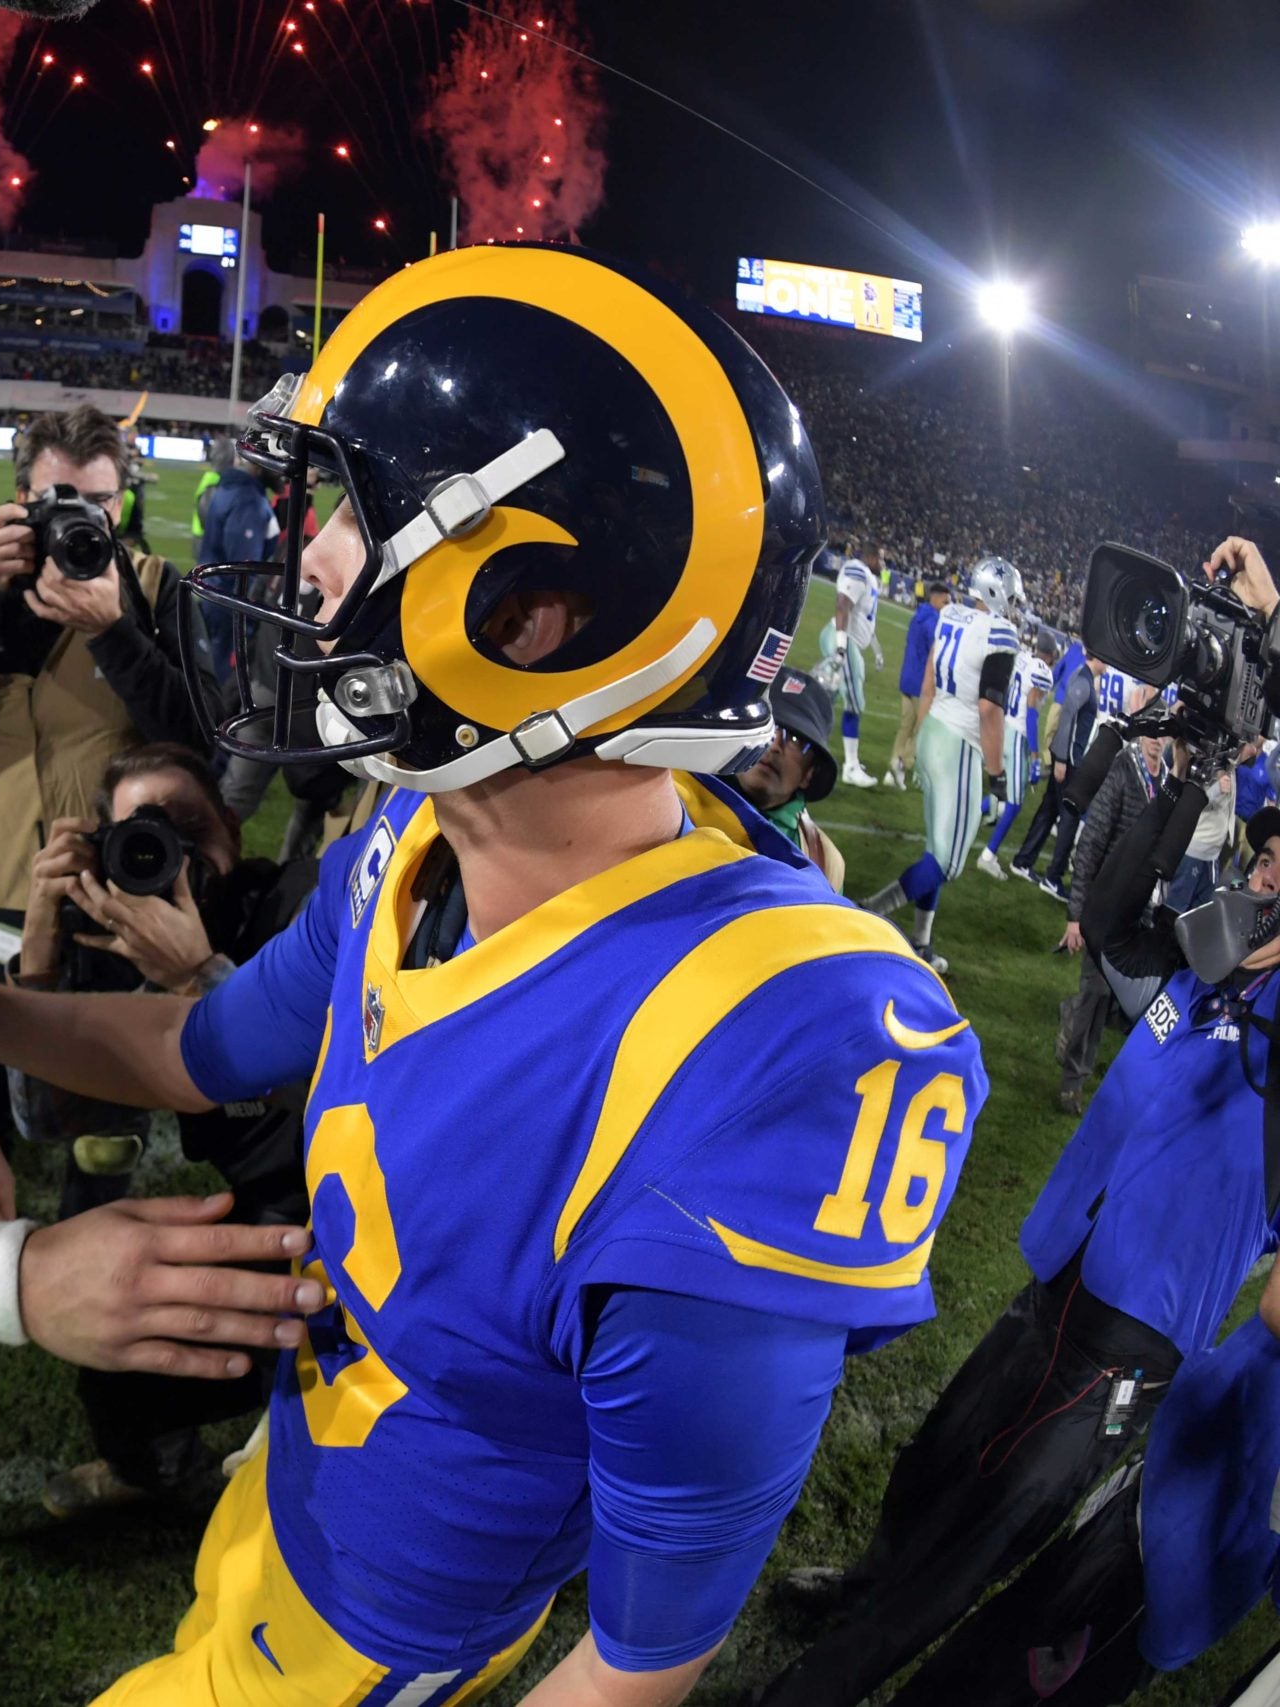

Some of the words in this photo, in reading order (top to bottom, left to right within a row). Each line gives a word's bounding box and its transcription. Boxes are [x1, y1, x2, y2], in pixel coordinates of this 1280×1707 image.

[767, 277, 855, 325] ONE
[935, 622, 964, 697] 71
[1149, 998, 1177, 1038] SDS
[813, 1058, 967, 1244] 16
